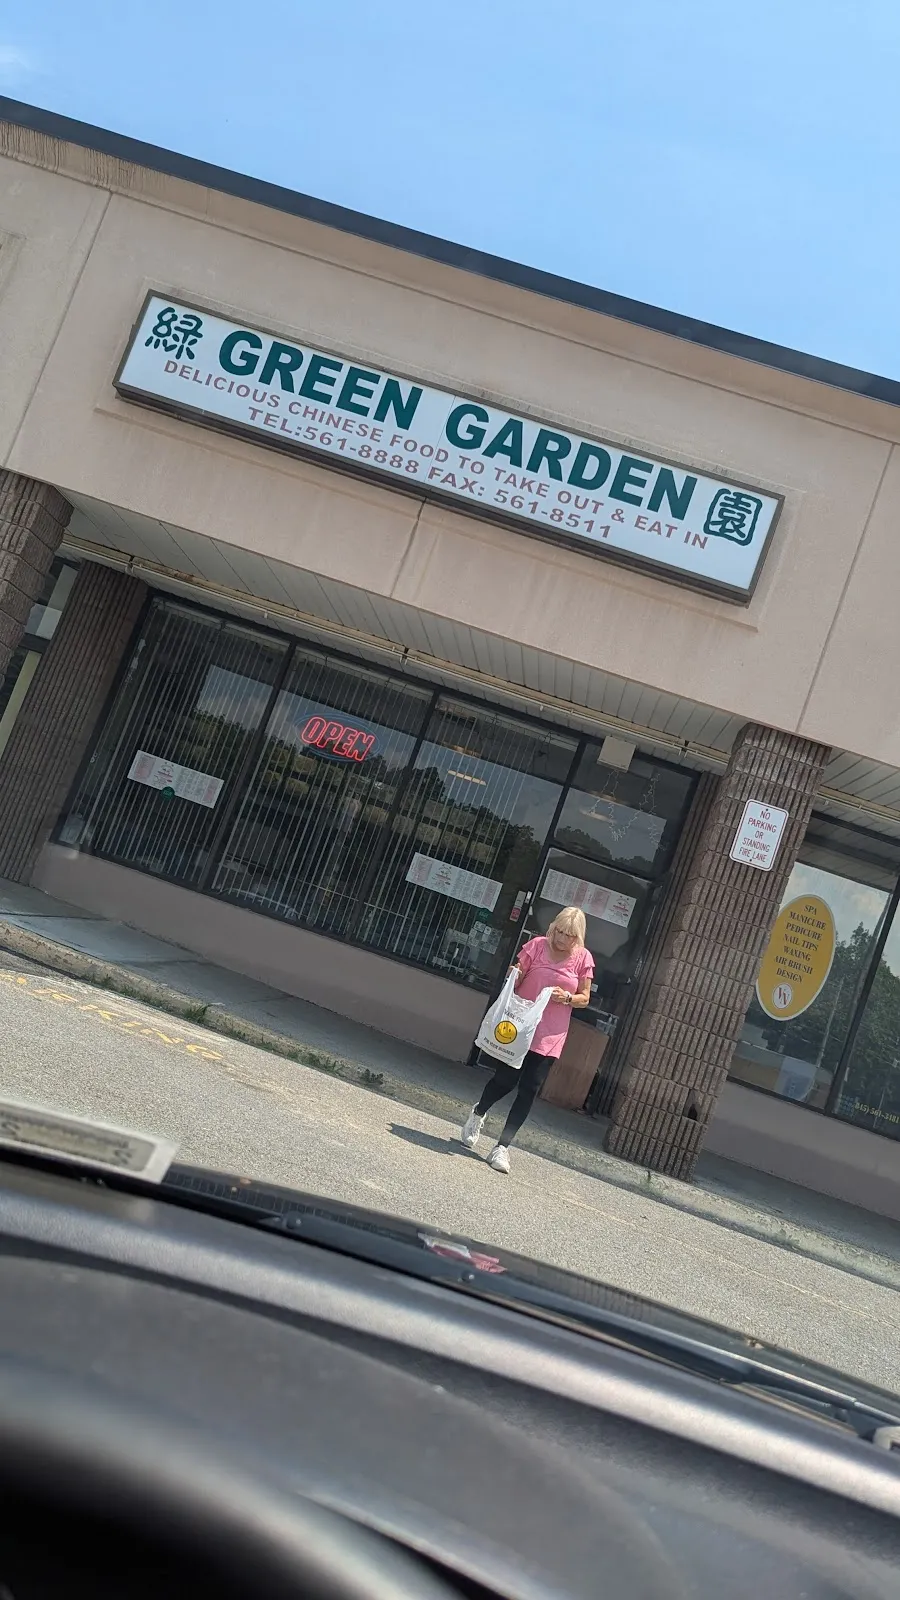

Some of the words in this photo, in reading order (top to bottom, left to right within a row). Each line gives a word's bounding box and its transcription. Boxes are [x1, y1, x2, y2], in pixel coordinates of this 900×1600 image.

[218, 330, 423, 431] GREEN
[445, 403, 698, 521] GARDEN
[164, 360, 281, 408] DELICIOUS
[288, 401, 384, 443] CHINESE
[389, 434, 449, 463] FOOD
[458, 455, 485, 475] TO
[494, 467, 550, 498] TAKE
[558, 490, 604, 515] OUT
[611, 507, 625, 523] &
[634, 515, 678, 540] EAT
[683, 530, 709, 549] IN
[248, 407, 420, 474] TEL:561-8888
[427, 466, 485, 496] FAX:
[493, 488, 611, 539] 561-8511
[702, 487, 763, 547] 園
[301, 716, 375, 762] OPEN
[760, 811, 771, 820] NO
[748, 817, 777, 833] PARKING
[755, 831, 763, 839] OR
[742, 837, 770, 852] STANDING
[739, 847, 752, 857] FIRE
[752, 851, 767, 863] LANE
[804, 904, 817, 915] SPA
[789, 911, 827, 931] MANICURE
[785, 922, 823, 941] PEDICURE
[783, 934, 800, 945] NAIL
[801, 939, 819, 951] TIPS
[783, 945, 811, 962] WAXING
[775, 955, 787, 966] AIR
[788, 959, 813, 974] BRUSH
[777, 968, 803, 983] DESIGN
